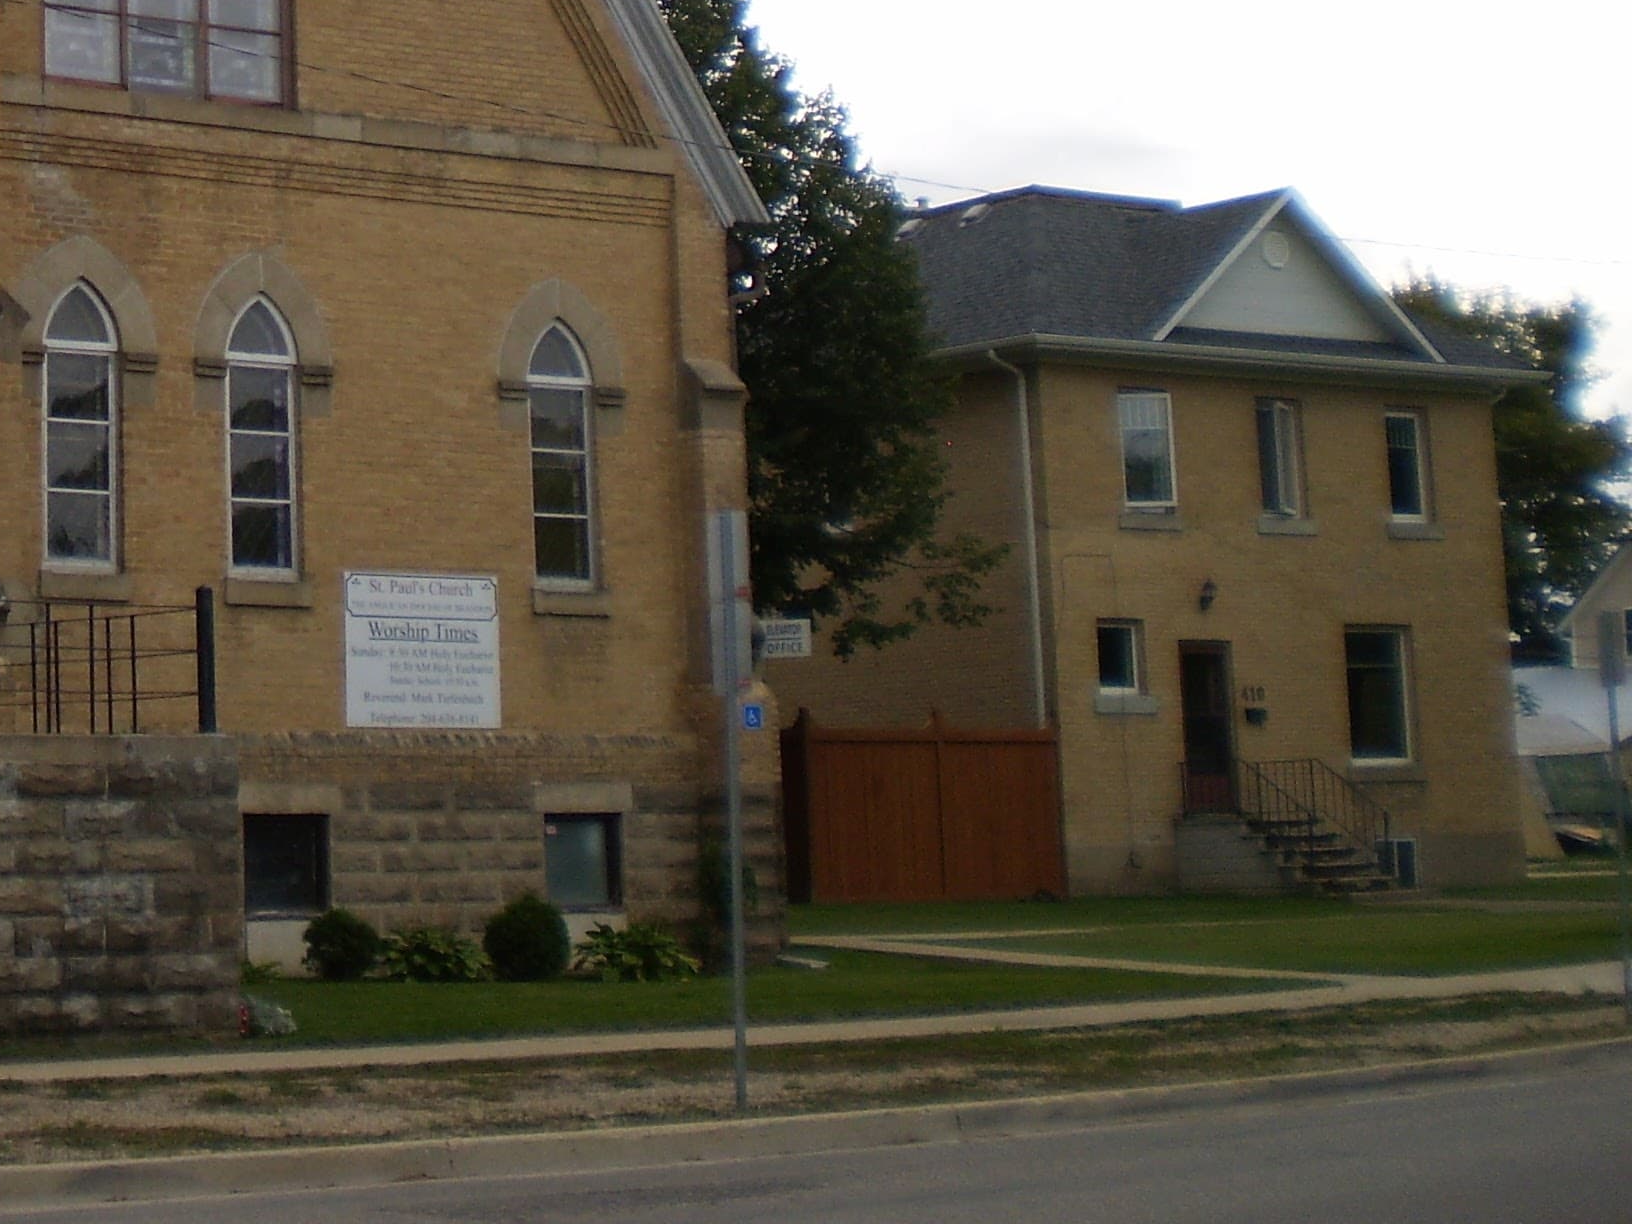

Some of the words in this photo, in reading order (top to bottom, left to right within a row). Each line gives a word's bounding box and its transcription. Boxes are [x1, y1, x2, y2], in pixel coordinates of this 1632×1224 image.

[369, 579, 385, 593] St.
[390, 579, 425, 595] Paul's
[428, 581, 473, 597] Church
[368, 621, 430, 643] Worship
[434, 623, 479, 641] Times
[412, 648, 428, 658] AM
[767, 642, 804, 654] OFFICE
[415, 662, 431, 672] AM
